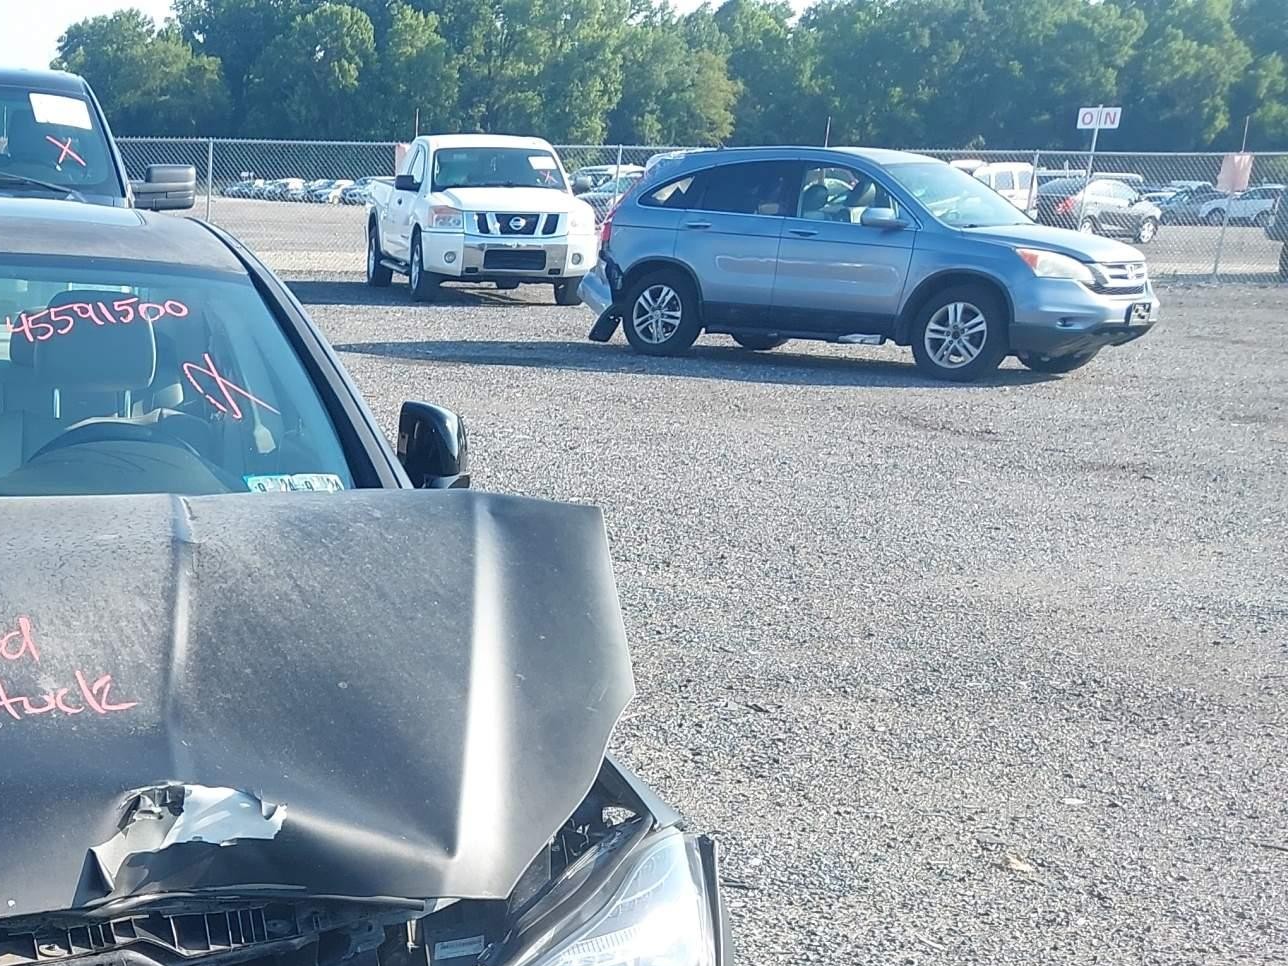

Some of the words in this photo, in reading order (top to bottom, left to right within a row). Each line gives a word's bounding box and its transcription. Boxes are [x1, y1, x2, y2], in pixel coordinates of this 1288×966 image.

[1082, 111, 1094, 126] O
[1104, 111, 1117, 125] N
[5, 297, 189, 342] 45591500
